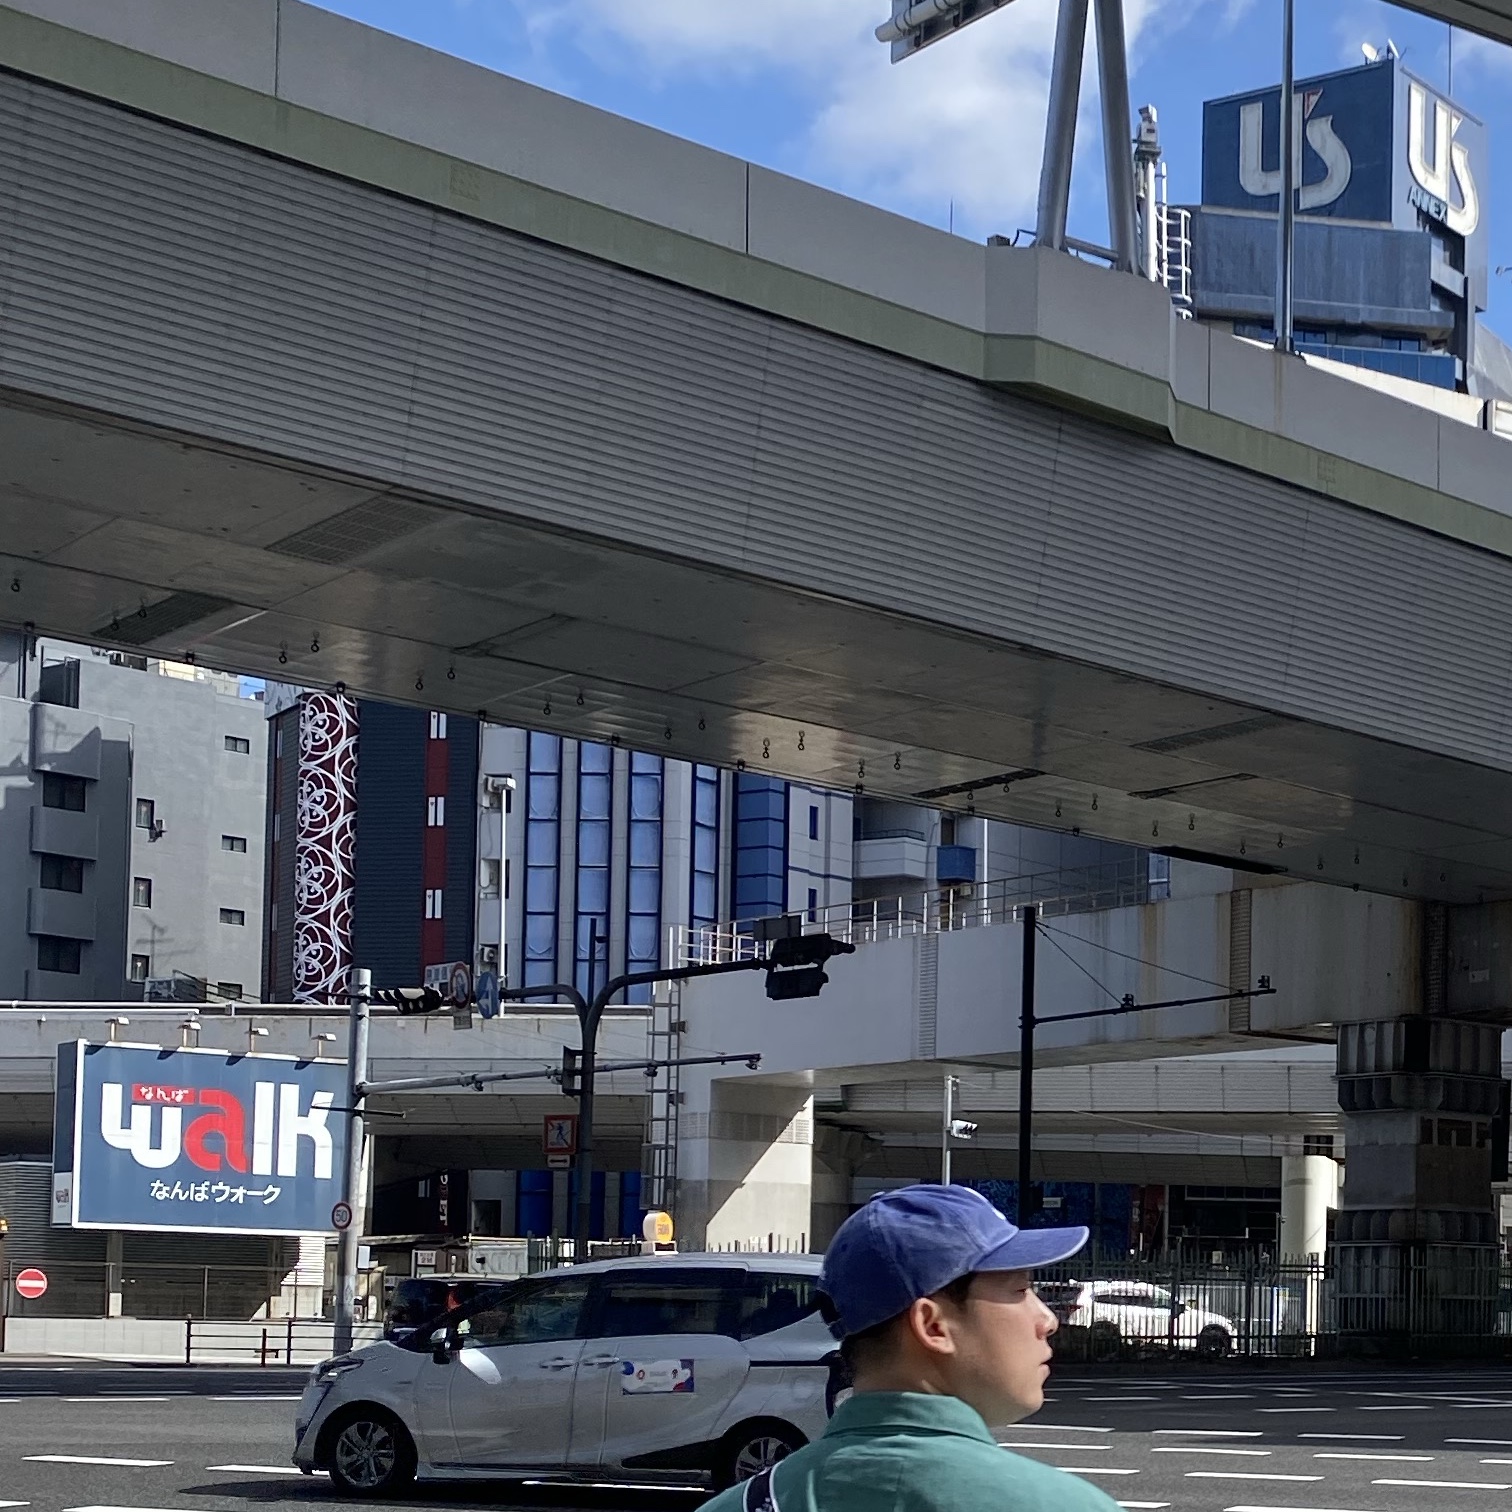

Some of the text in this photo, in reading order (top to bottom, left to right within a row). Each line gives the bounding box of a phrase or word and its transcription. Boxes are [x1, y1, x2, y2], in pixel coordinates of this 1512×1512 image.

[139, 1086, 189, 1102] なんば
[101, 1081, 335, 1180] walk
[150, 1180, 282, 1205] なんばウォーク
[336, 1209, 348, 1223] 50
